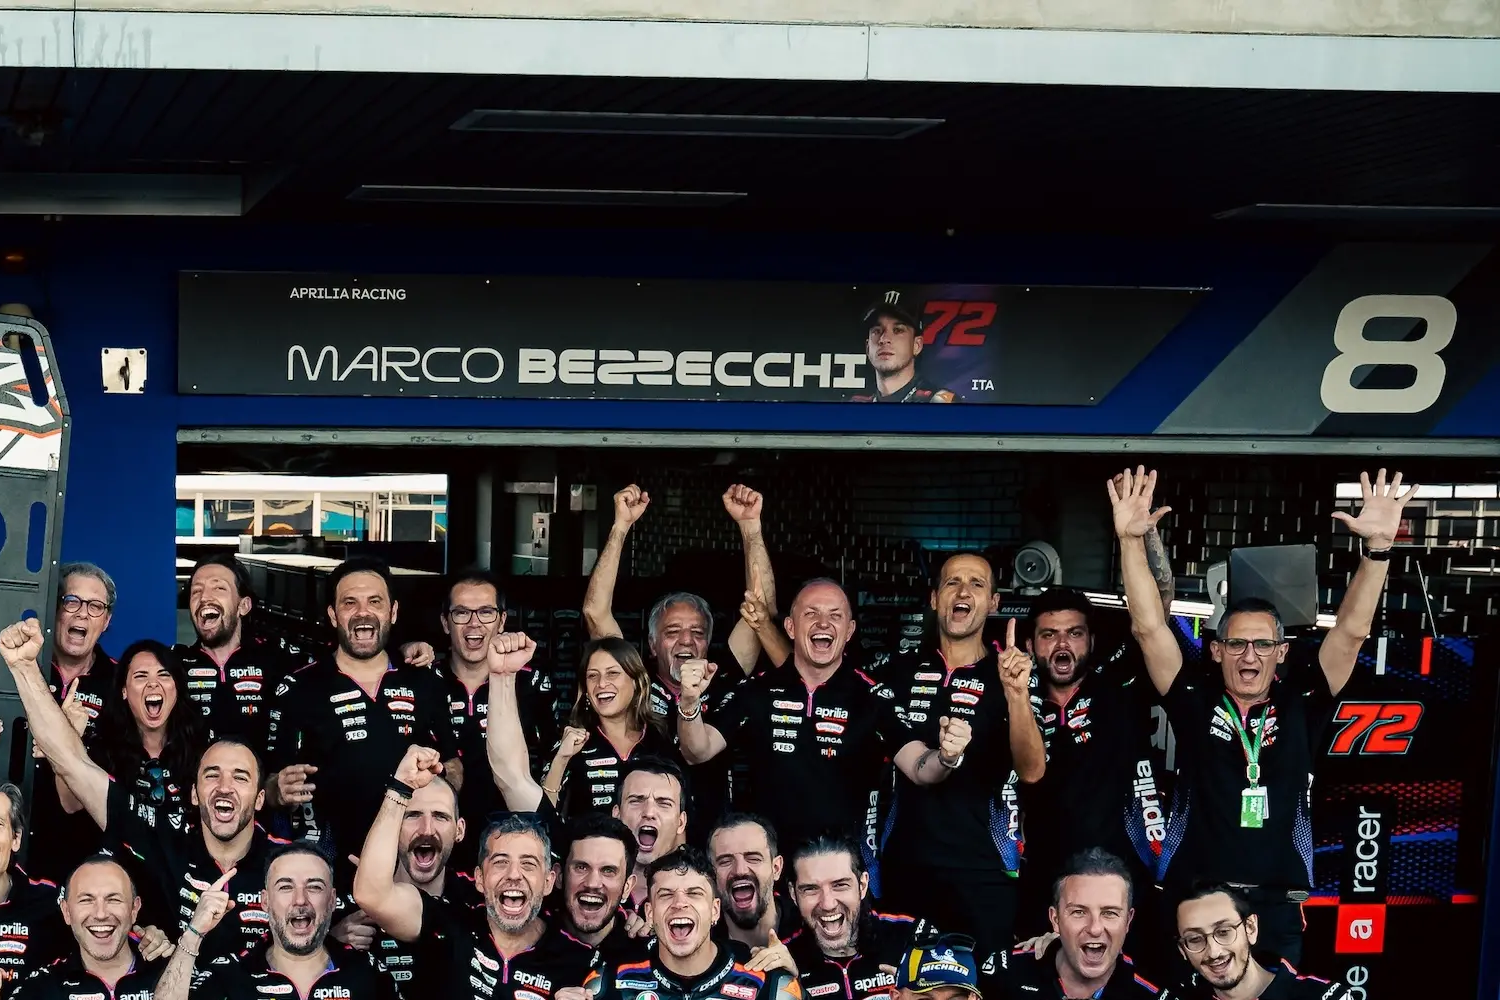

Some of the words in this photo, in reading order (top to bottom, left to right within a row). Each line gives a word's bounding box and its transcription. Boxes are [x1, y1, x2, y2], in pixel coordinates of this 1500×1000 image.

[289, 287, 350, 299] APRILIA
[352, 288, 407, 300] RACING
[921, 299, 999, 346] 72
[1320, 294, 1458, 414] 8
[287, 345, 506, 384] MARCO
[518, 347, 867, 390] BEZZECCHI
[971, 378, 995, 391] ITA
[229, 666, 263, 679] aprilia
[951, 677, 985, 692] aprilia
[383, 686, 415, 698] aprilia
[391, 713, 416, 722] TARGA
[814, 706, 849, 719] aprilia
[949, 706, 976, 715] TARGA
[772, 728, 798, 737] BS
[1328, 700, 1425, 756] 72
[815, 735, 843, 744] TARGA
[591, 783, 615, 791] BS
[1133, 759, 1167, 842] aprilia
[1352, 805, 1382, 894] racer
[1350, 918, 1373, 940] a
[386, 955, 414, 964] BS
[476, 952, 499, 969] Castrol
[395, 972, 411, 980] FES
[699, 957, 735, 993] DAINESE
[920, 963, 970, 977] MICHELIN
[513, 969, 552, 991] aprilia
[854, 972, 896, 993] aprilia
[313, 985, 351, 1000] aprilia
[810, 983, 838, 996] Castrol
